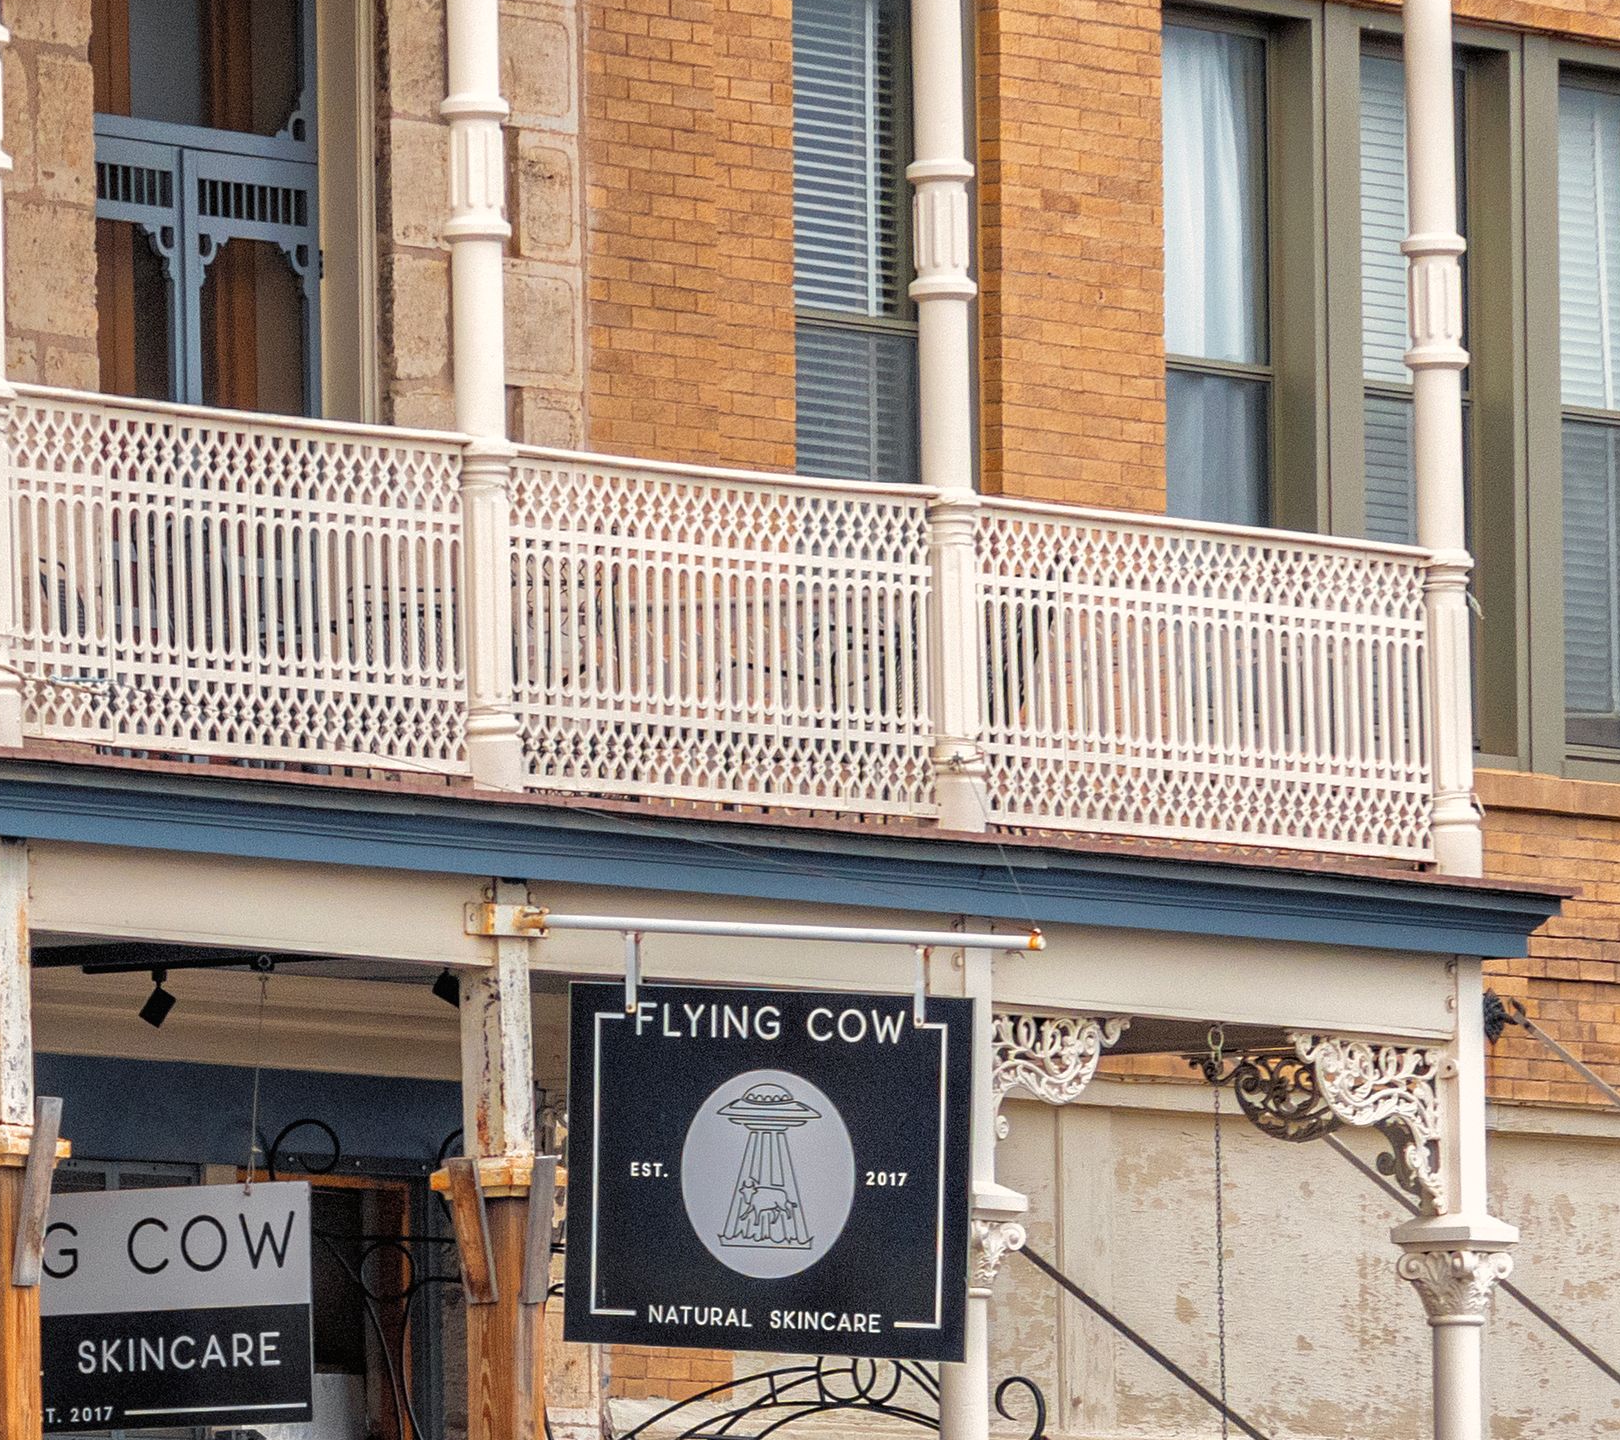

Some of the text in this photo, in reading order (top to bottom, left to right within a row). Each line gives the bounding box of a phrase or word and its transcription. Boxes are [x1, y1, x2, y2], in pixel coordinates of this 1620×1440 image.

[635, 1002, 906, 1044] FLYING COW
[630, 1162, 668, 1178] EST.
[865, 1171, 908, 1188] 2017
[127, 1210, 295, 1275] COW
[648, 1304, 882, 1334] NATURAL SKINCARE
[76, 1331, 282, 1375] SKINCARE
[69, 1405, 114, 1423] 2017
